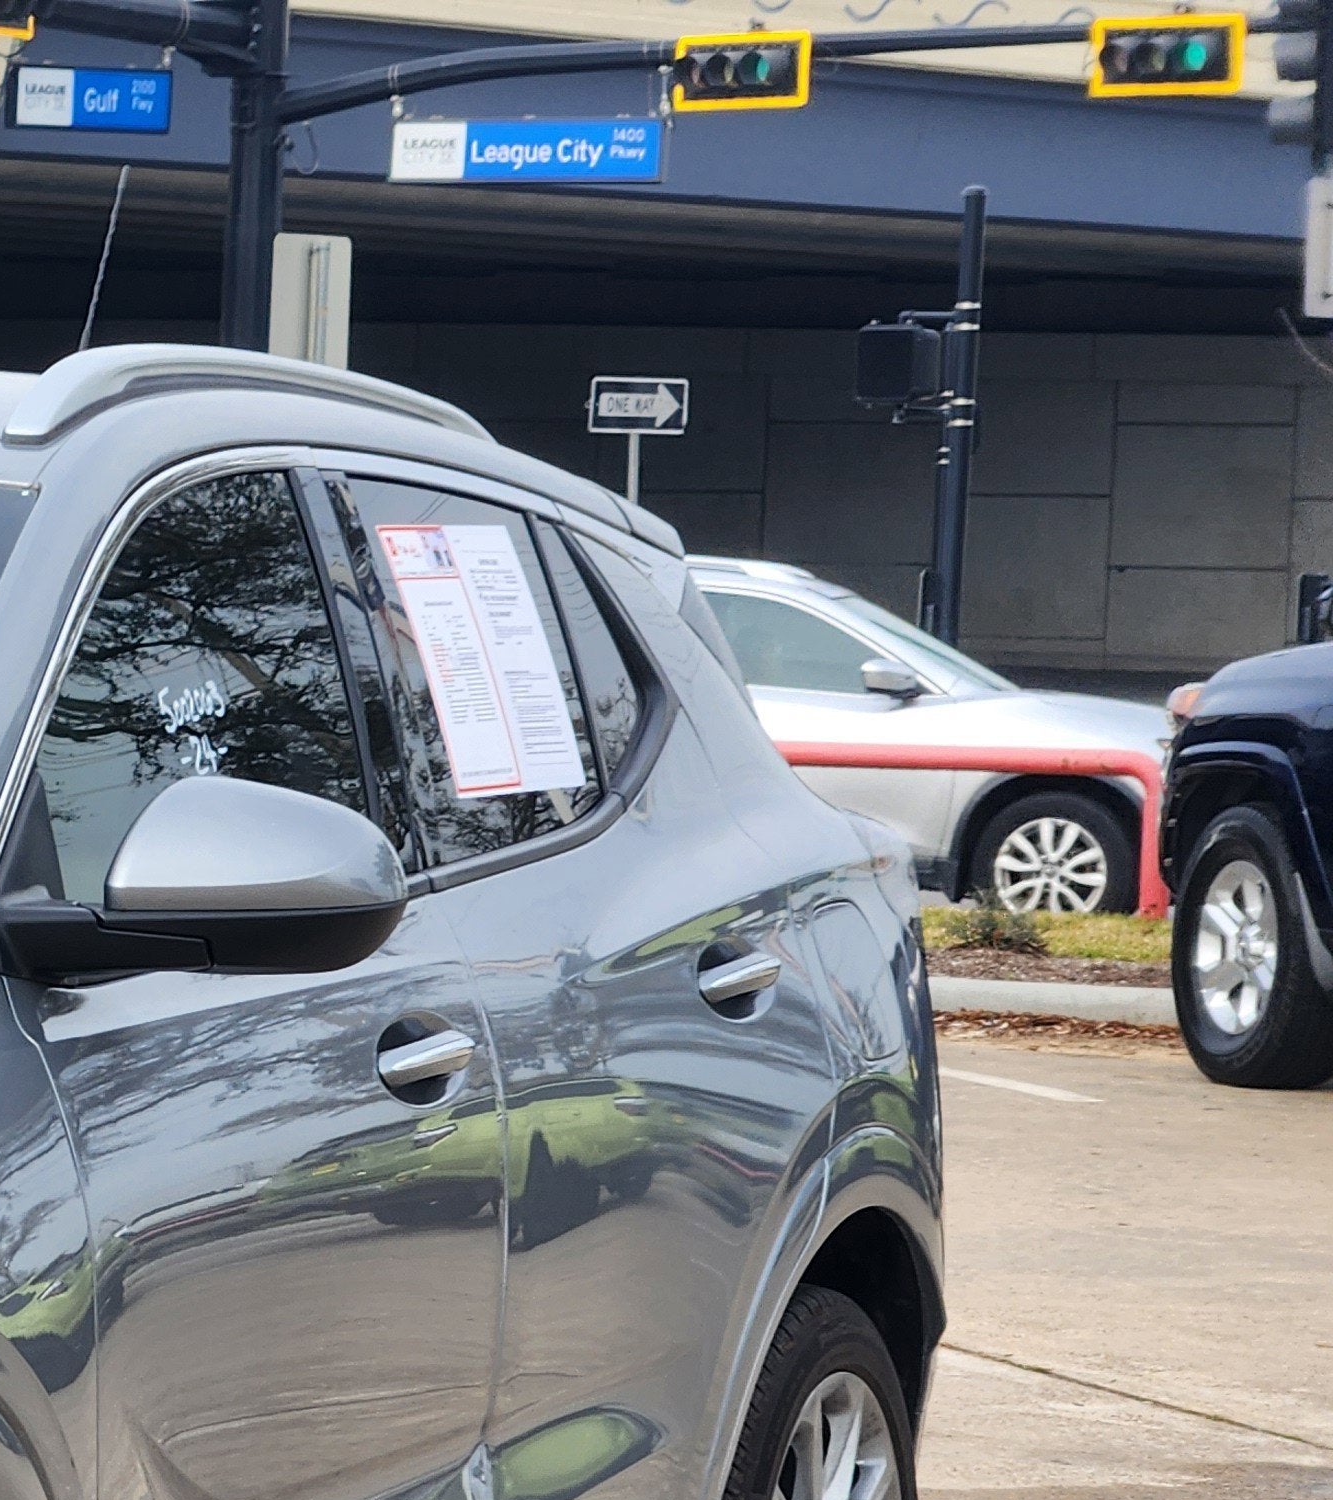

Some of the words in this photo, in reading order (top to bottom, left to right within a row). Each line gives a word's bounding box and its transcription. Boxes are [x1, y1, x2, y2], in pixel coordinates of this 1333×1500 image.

[83, 87, 120, 113] Gulf
[612, 127, 646, 142] 1400
[402, 138, 457, 150] LEAGUE
[469, 139, 552, 170] League
[555, 137, 604, 168] City
[606, 396, 631, 413] ONE
[634, 396, 656, 413] WAY
